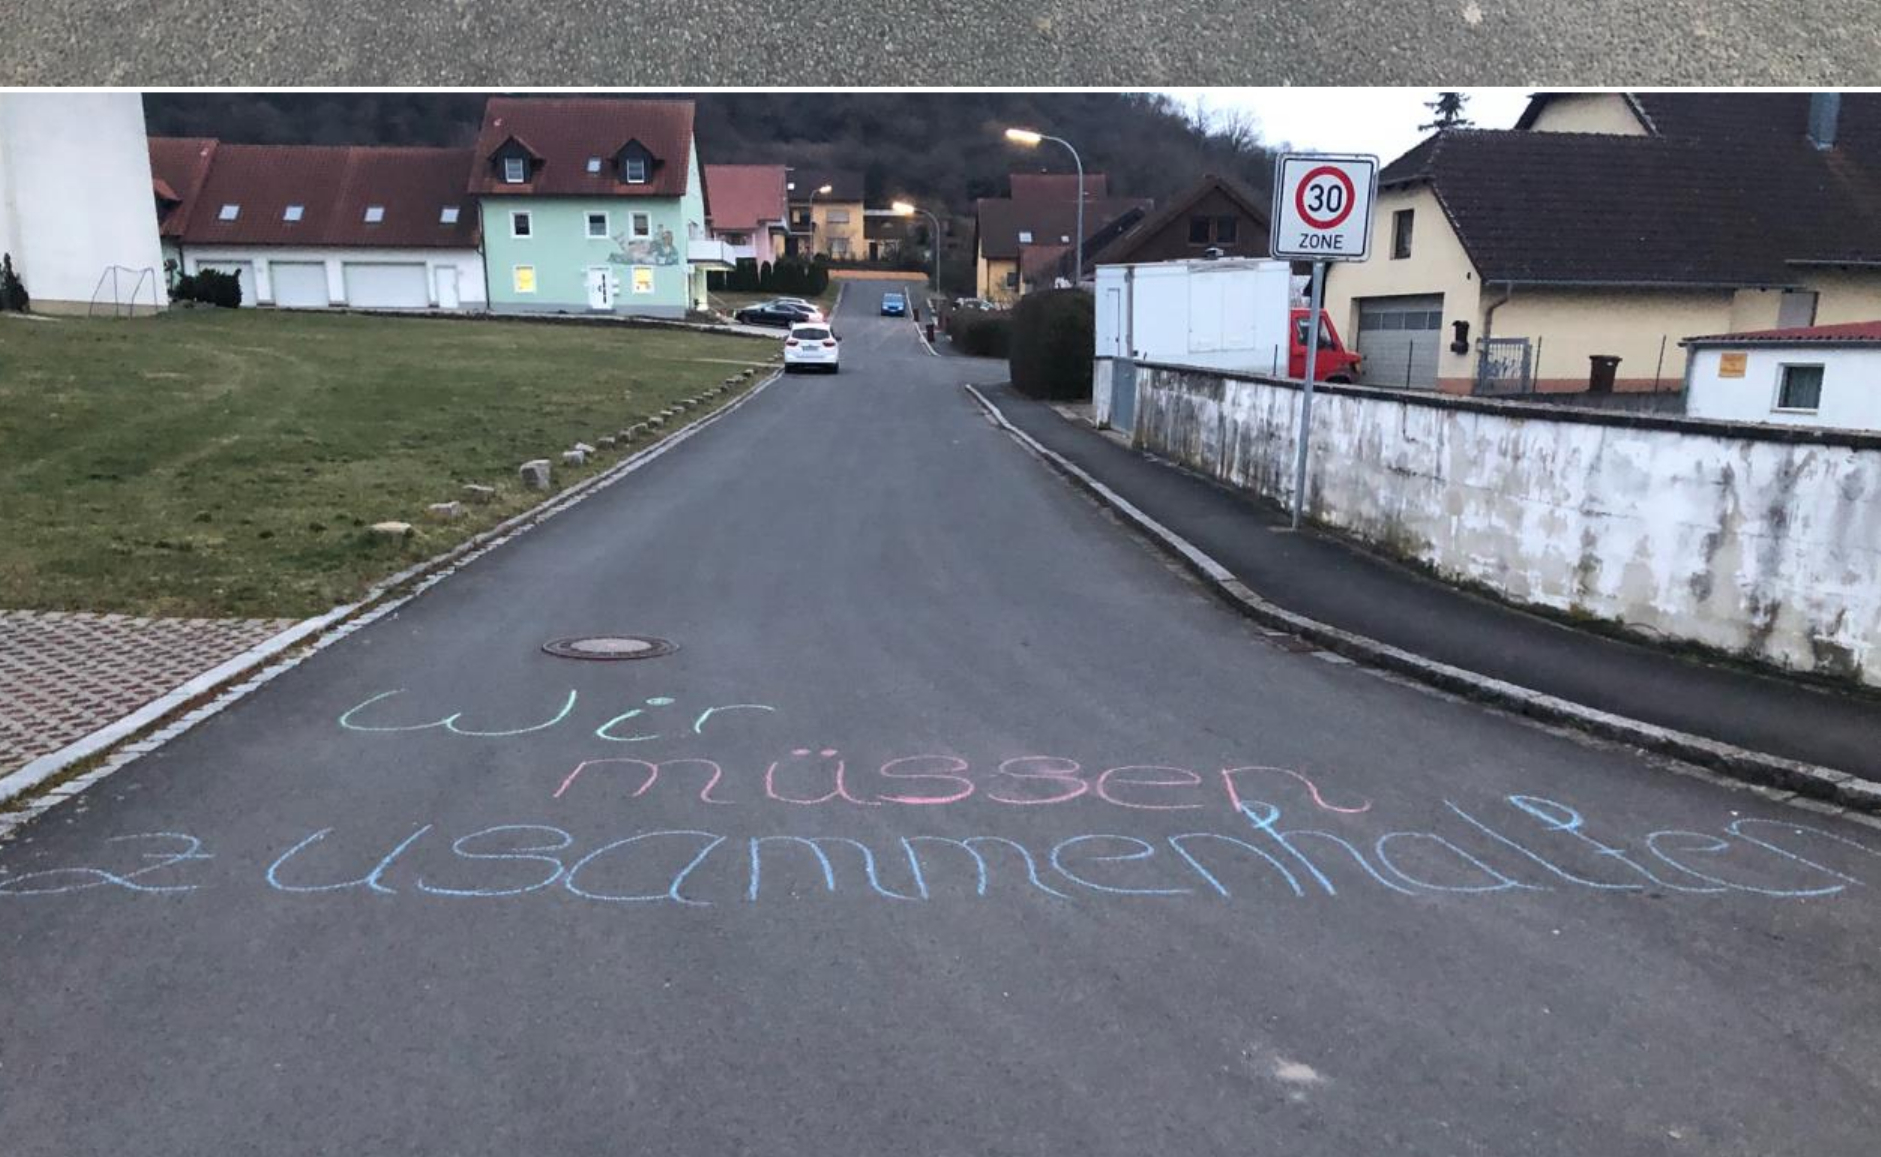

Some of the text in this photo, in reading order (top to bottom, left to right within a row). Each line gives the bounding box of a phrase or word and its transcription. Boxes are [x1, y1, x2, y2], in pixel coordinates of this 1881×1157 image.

[1308, 184, 1342, 213] 30
[1299, 233, 1344, 249] ZONE
[553, 746, 1373, 814] müssen
